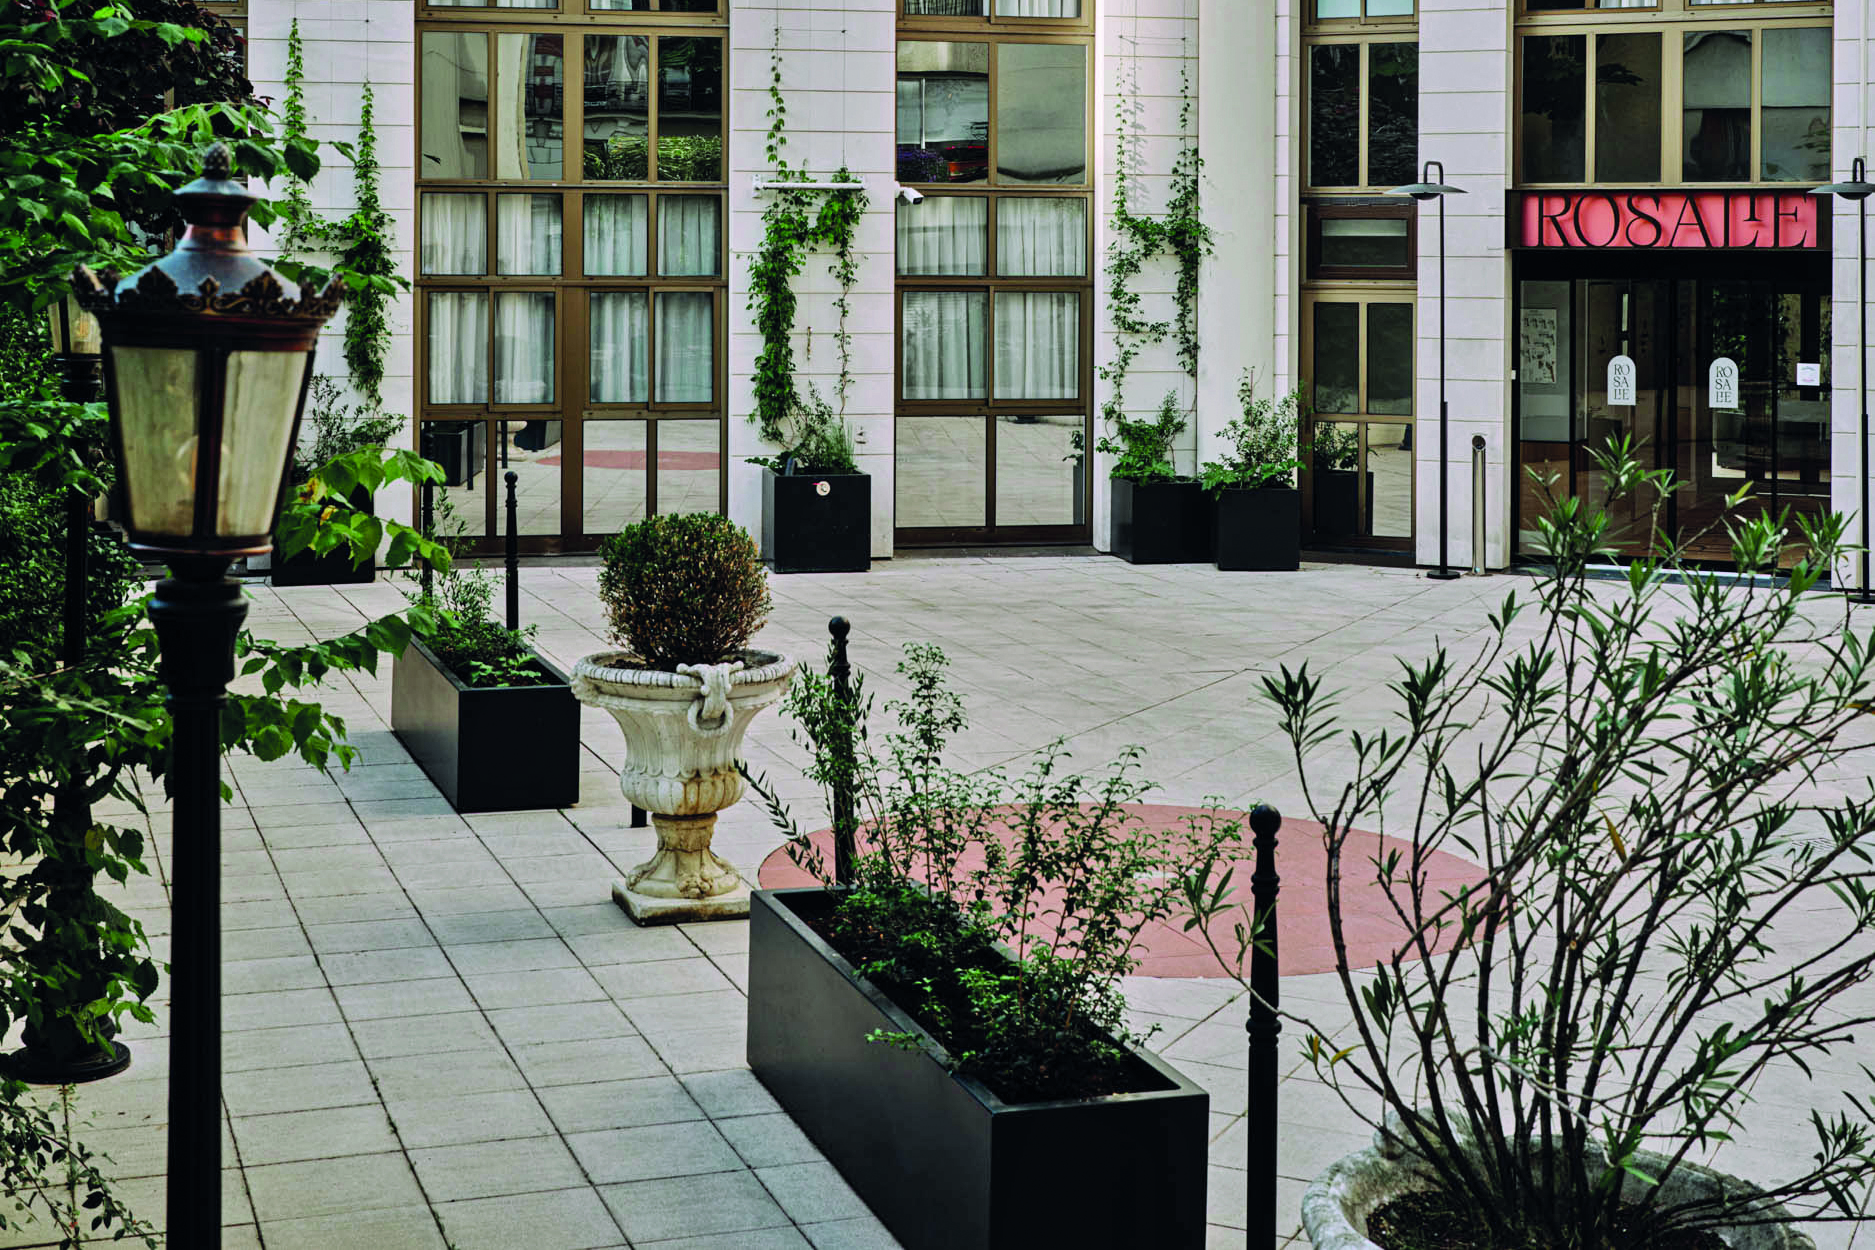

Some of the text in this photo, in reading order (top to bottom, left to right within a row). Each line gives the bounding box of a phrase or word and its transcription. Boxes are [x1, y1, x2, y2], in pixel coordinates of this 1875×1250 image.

[1530, 192, 1808, 248] ROSALIE
[1614, 364, 1630, 375] RO
[1716, 366, 1732, 378] RO
[1613, 376, 1629, 388] SA
[1715, 378, 1731, 390] SA
